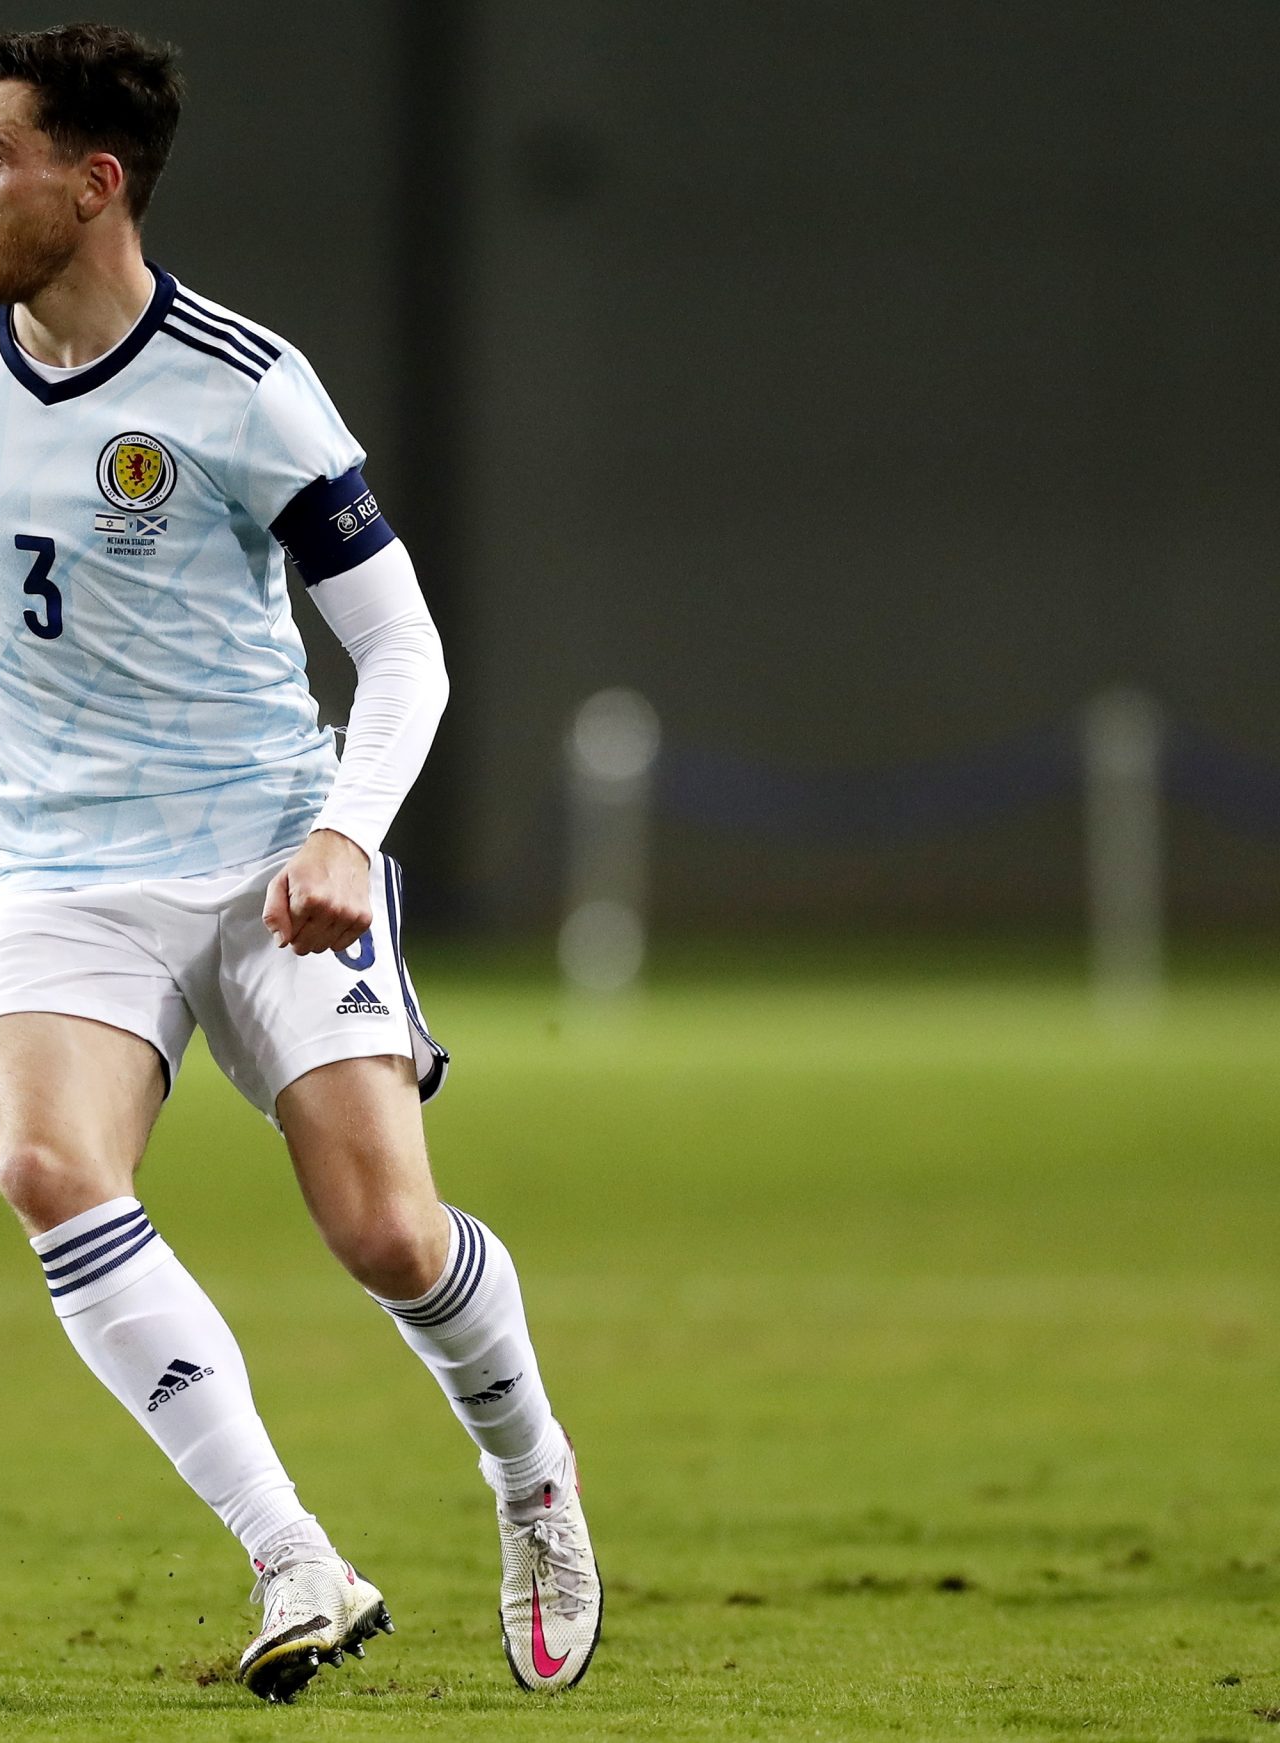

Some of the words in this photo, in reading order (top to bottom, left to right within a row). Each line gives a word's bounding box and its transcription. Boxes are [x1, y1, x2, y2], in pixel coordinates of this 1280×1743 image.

[122, 437, 159, 450] SCOTLAND
[107, 537, 130, 545] NETANYA
[131, 538, 155, 546] STADIUM
[114, 547, 142, 556] NOVEMBER
[142, 548, 156, 556] 2020
[14, 533, 63, 640] 3
[336, 1001, 390, 1015] adidas
[147, 1366, 215, 1412] adidas
